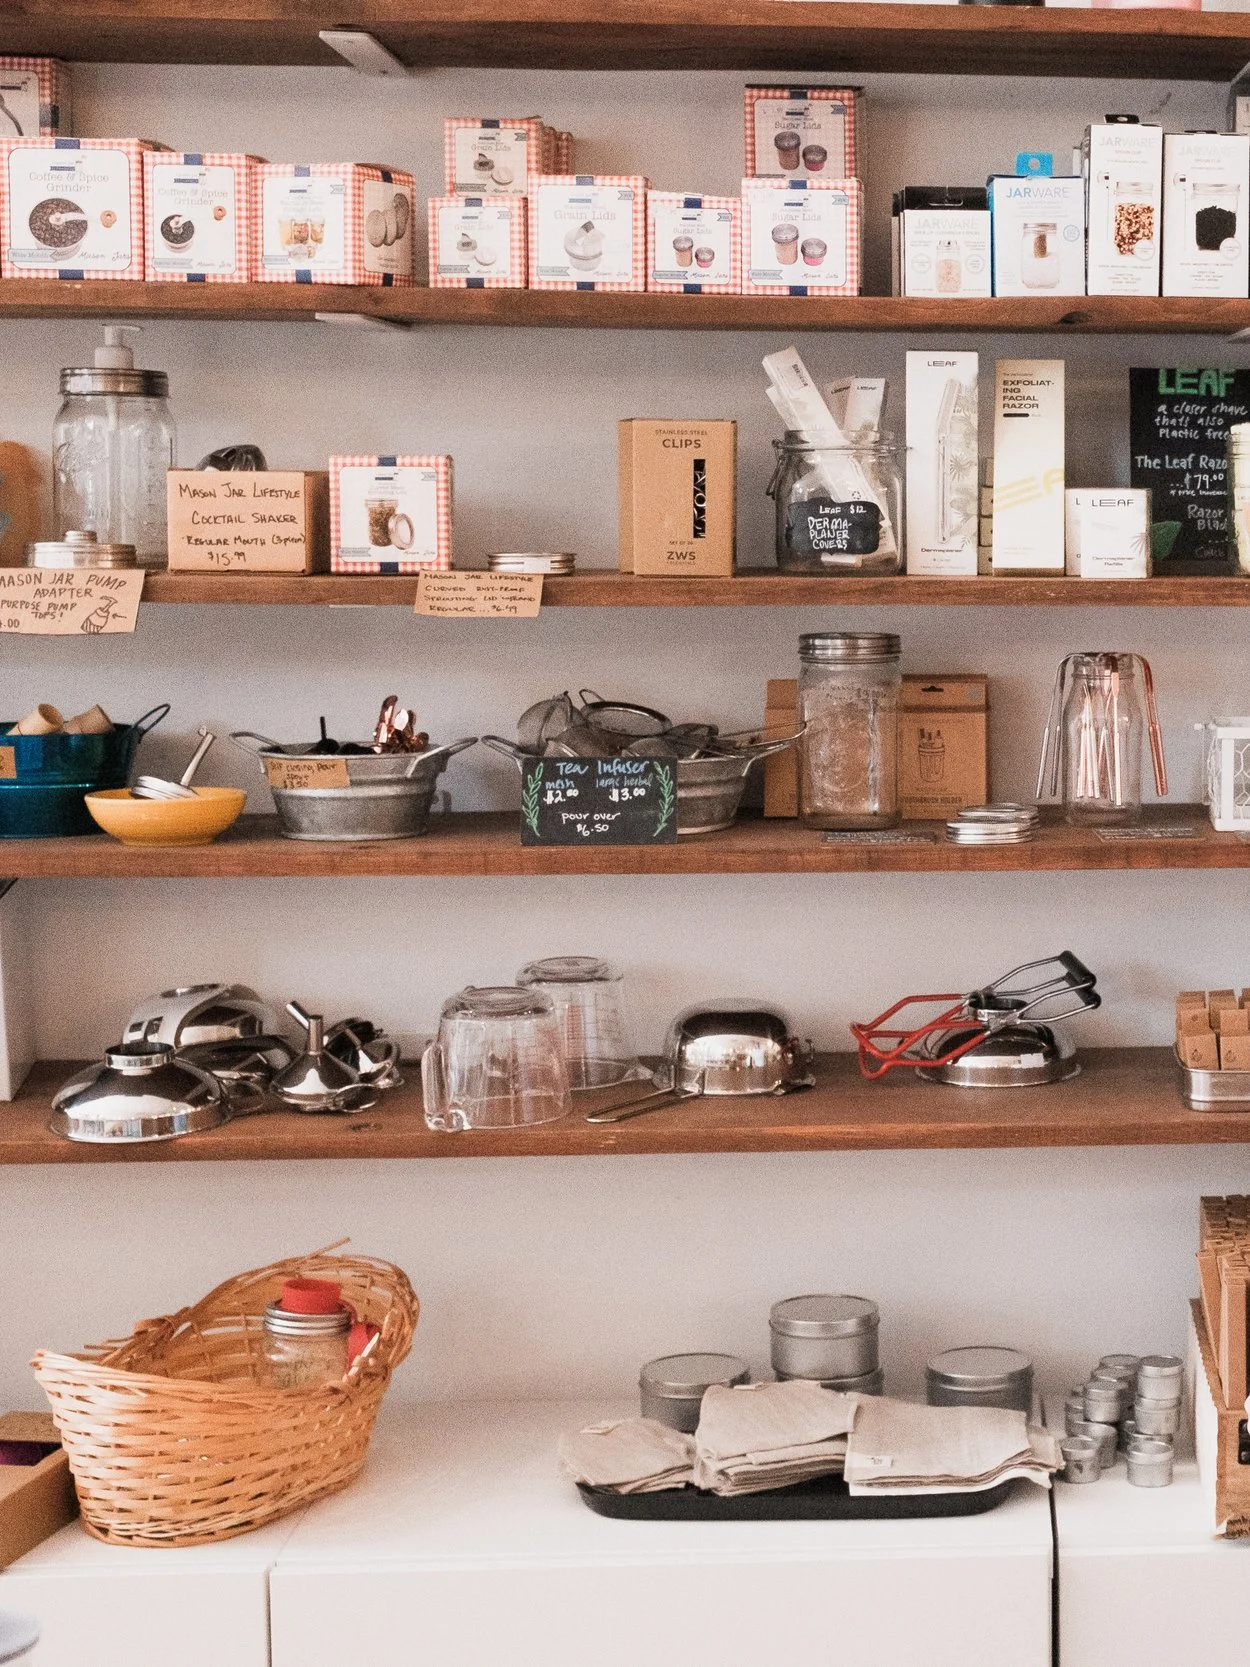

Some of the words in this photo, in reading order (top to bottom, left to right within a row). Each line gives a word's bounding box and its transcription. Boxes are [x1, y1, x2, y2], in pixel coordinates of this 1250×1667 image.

[774, 121, 799, 130] Sugar
[803, 121, 822, 129] Lids
[471, 143, 493, 152] Grain
[495, 143, 511, 152] Lids
[1099, 136, 1155, 148] JARWARE
[29, 171, 62, 182] Coffee
[66, 171, 77, 182] &
[79, 172, 110, 184] Spice
[46, 183, 92, 193] Grinder
[157, 188, 188, 198] Coffee
[202, 189, 229, 199] Spice
[1006, 187, 1070, 198] JARWARE
[174, 198, 215, 207] Grinder
[554, 210, 588, 220] Grain
[591, 210, 617, 221] Lids
[772, 212, 798, 222] Sugar
[802, 212, 822, 222] Lids
[454, 224, 475, 232] Grain
[914, 218, 979, 230] JARWARE
[673, 227, 697, 235] Sugar
[1158, 368, 1235, 397] LEAF
[1173, 402, 1207, 415] closer
[1212, 402, 1249, 416] shave
[1197, 416, 1224, 427] also
[662, 438, 702, 449] CLIPS
[1135, 454, 1162, 469] The
[1164, 453, 1196, 469] Leaf
[1199, 454, 1228, 470] Razo
[179, 483, 217, 498] MASON
[221, 482, 246, 498] JAR
[252, 482, 300, 500] LIFESTYLE
[1092, 499, 1134, 507] LEAF
[850, 504, 867, 514] $12
[1187, 504, 1225, 519] Razor
[191, 510, 246, 525] COCKTAIL
[251, 512, 298, 525] SHAKER
[1197, 517, 1228, 531] Blad
[234, 535, 266, 546] MOUTH
[809, 529, 850, 541] PLANER
[812, 539, 848, 550] COVERS
[667, 551, 696, 560] ZWS
[48, 573, 75, 586] JAR
[86, 574, 127, 590] PUMP
[33, 588, 93, 599] ADAPTER
[47, 602, 77, 612] PUMP
[429, 604, 475, 612] REGULAR
[555, 762, 590, 775] Tea
[598, 759, 648, 776] Infuser
[545, 779, 575, 789] mesh
[562, 811, 590, 825] pour
[593, 812, 621, 822] over
[576, 822, 610, 837] $6.50
